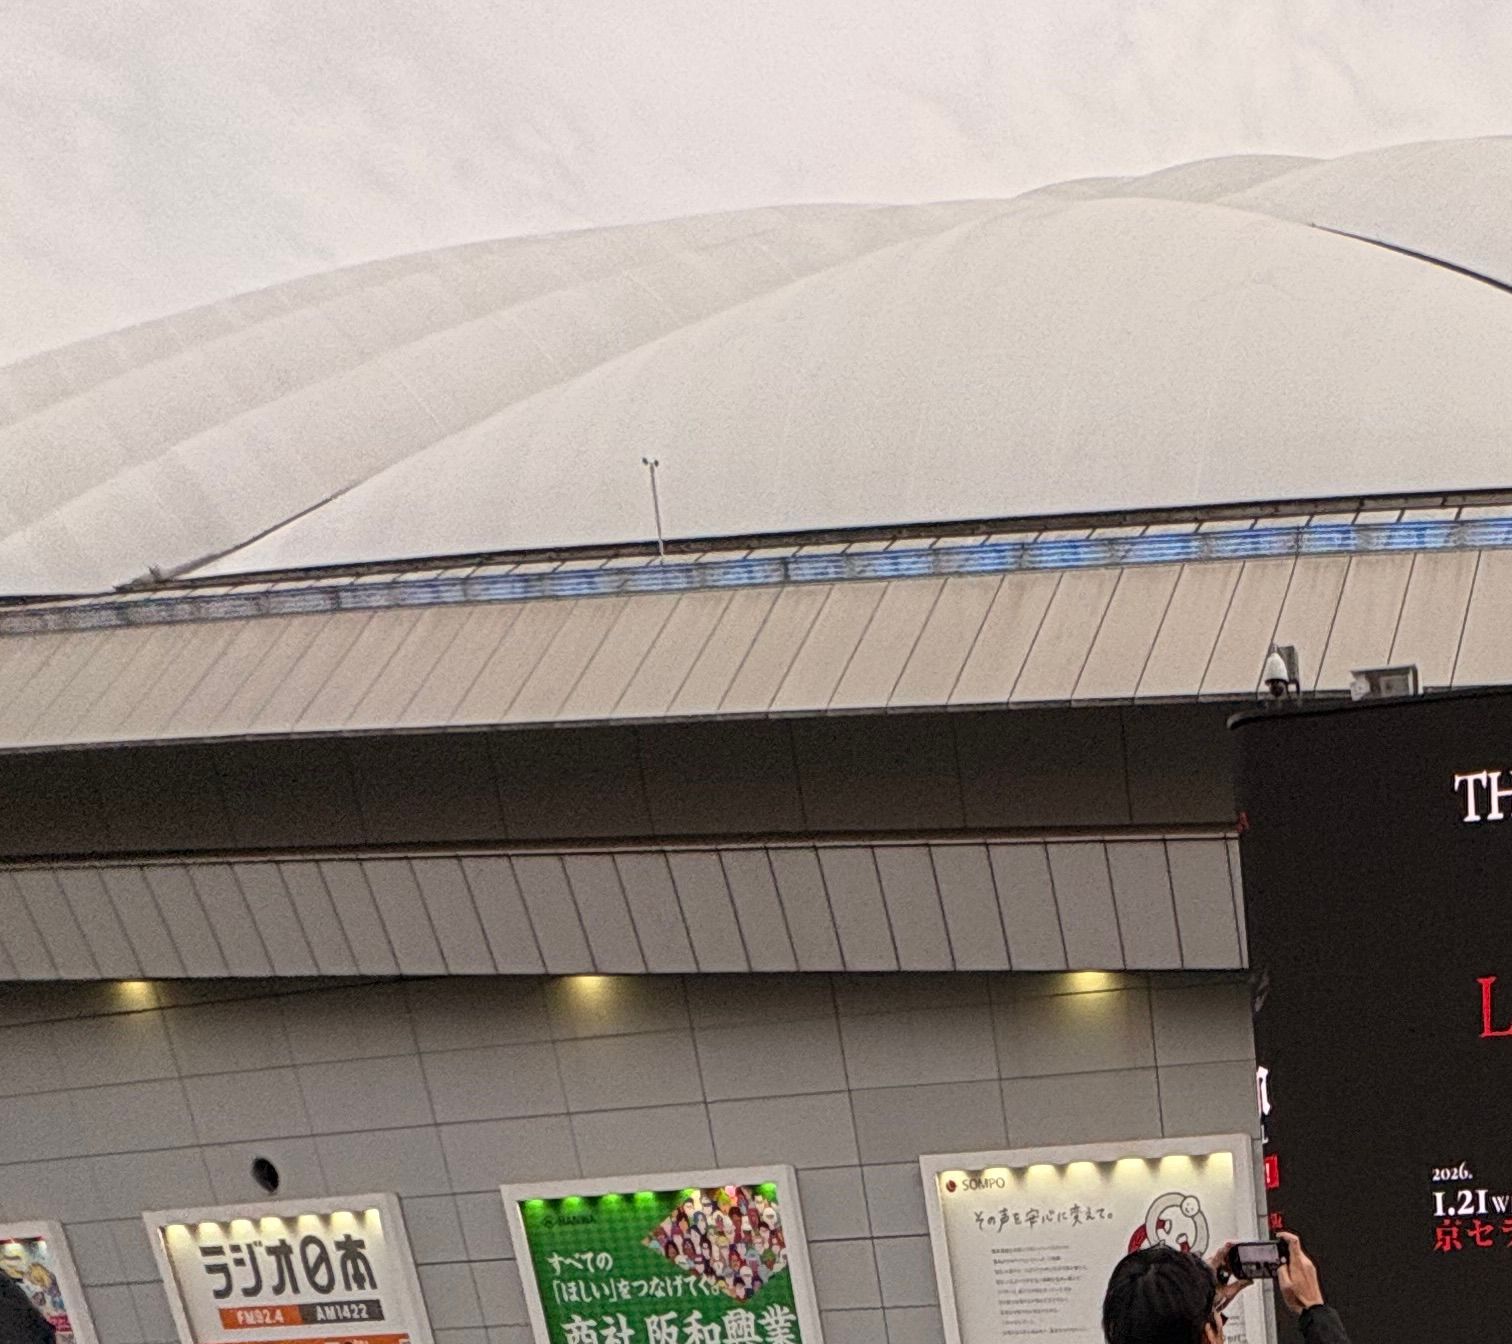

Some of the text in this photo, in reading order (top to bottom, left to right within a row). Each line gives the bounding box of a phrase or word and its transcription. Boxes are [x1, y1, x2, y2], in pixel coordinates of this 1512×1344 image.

[962, 1177, 1005, 1191] SOMPO
[199, 1234, 378, 1299] ラジオ日本
[548, 1252, 613, 1275] すべての
[236, 1309, 285, 1325] FM92.4
[316, 1303, 369, 1321] AM1422
